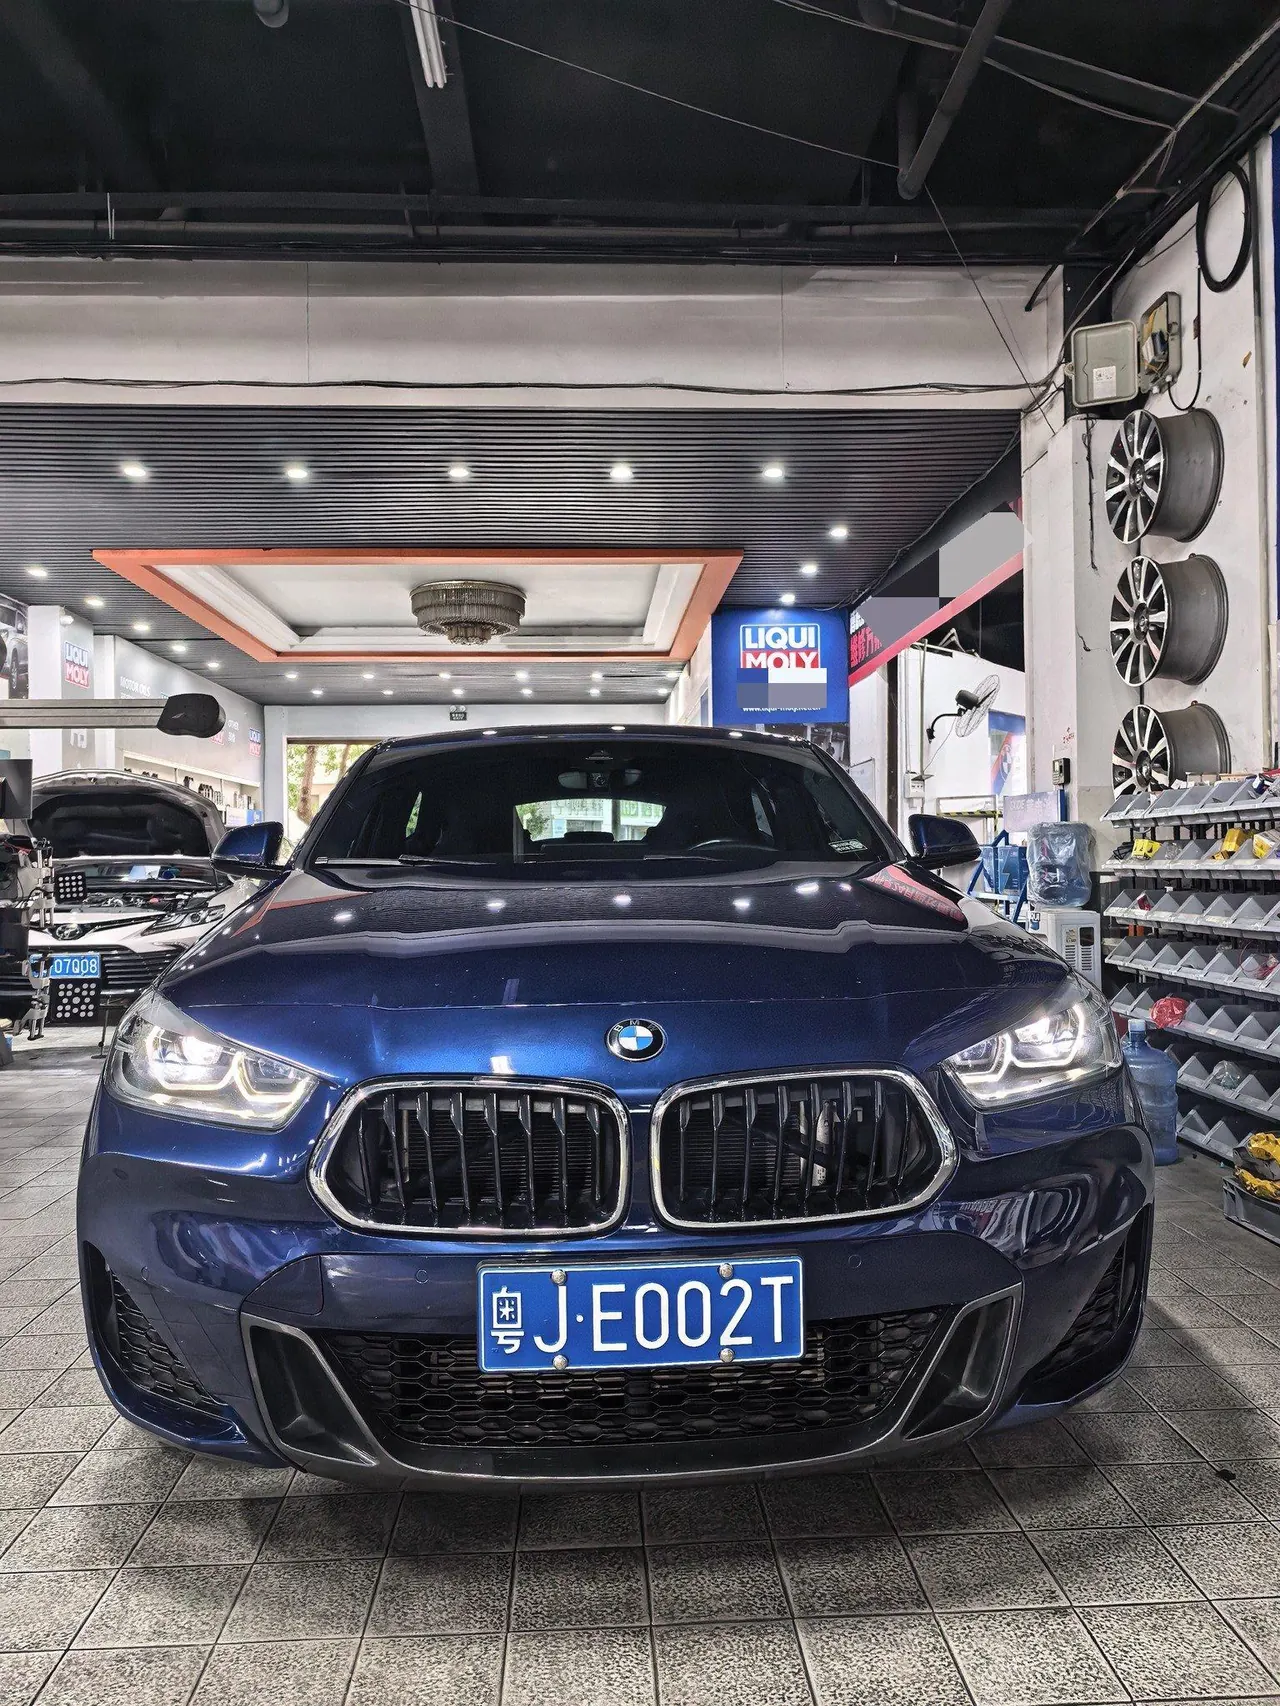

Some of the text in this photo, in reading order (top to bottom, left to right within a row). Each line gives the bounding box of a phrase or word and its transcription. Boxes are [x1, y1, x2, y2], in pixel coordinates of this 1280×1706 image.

[745, 626, 815, 650] LIQUI
[745, 651, 819, 668] MOLY
[65, 663, 89, 686] MOLY
[54, 959, 97, 973] 07Q08
[613, 1019, 658, 1033] BMW
[490, 1275, 795, 1354] 粤J·E002T
